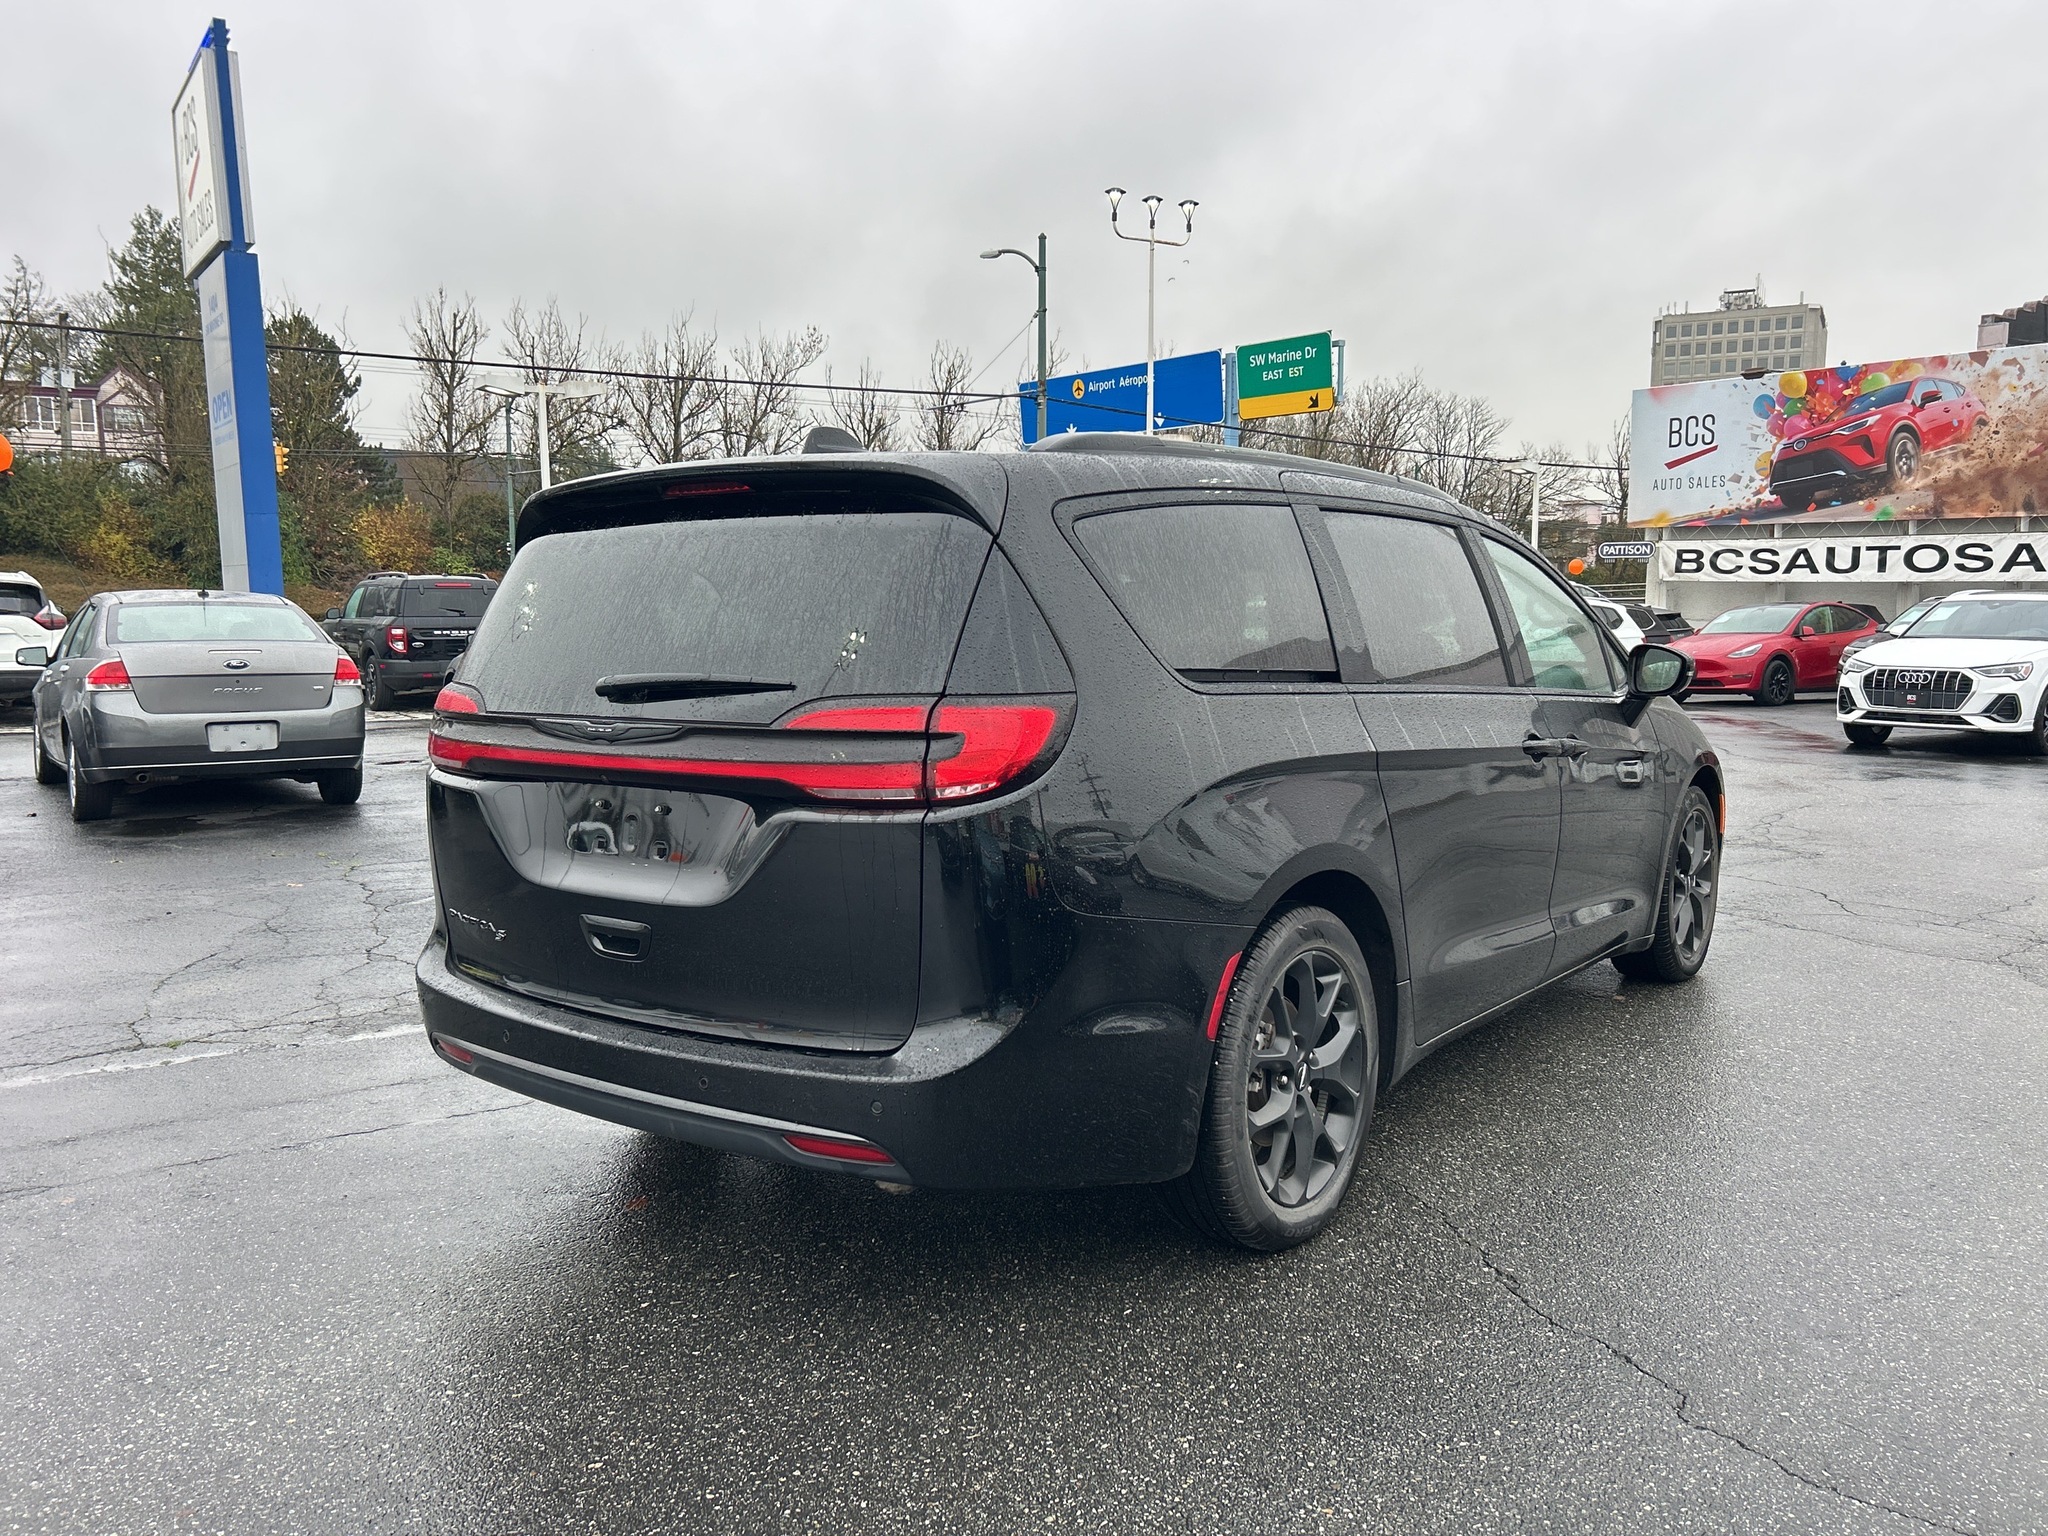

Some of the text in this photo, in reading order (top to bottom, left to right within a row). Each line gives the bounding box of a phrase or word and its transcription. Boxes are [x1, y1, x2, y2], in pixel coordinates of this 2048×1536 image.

[1249, 346, 1318, 368] SW Marine Dr
[1088, 374, 1155, 394] Airport Aéropo
[1262, 366, 1304, 381] EAST EST
[212, 388, 233, 424] OPEN
[1668, 413, 1716, 448] BCS
[1652, 475, 1726, 491] AUTO SALES
[1602, 544, 1651, 555] PATTISON
[1674, 542, 2047, 575] BCSAUTOSA
